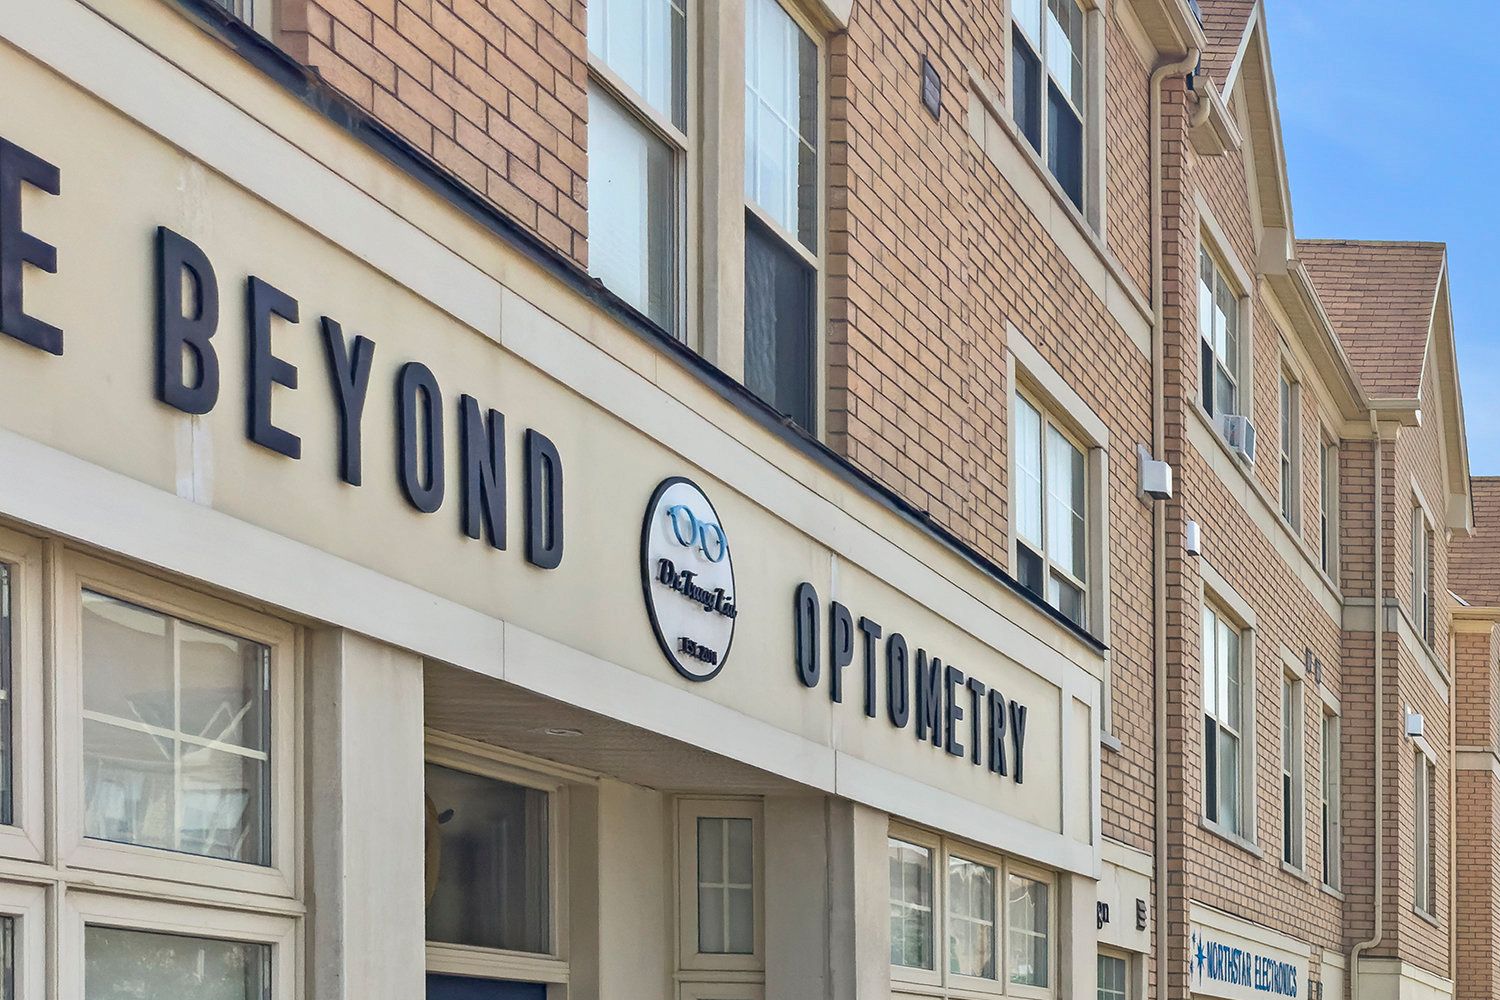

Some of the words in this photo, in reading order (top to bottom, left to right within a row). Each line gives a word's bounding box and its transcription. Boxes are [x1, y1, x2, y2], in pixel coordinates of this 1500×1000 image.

[155, 226, 564, 570] BEYOND
[795, 582, 1028, 785] OPTOMETRY
[1206, 941, 1252, 988] NORTHSTAR
[1254, 955, 1298, 999] ELECTRONICS
